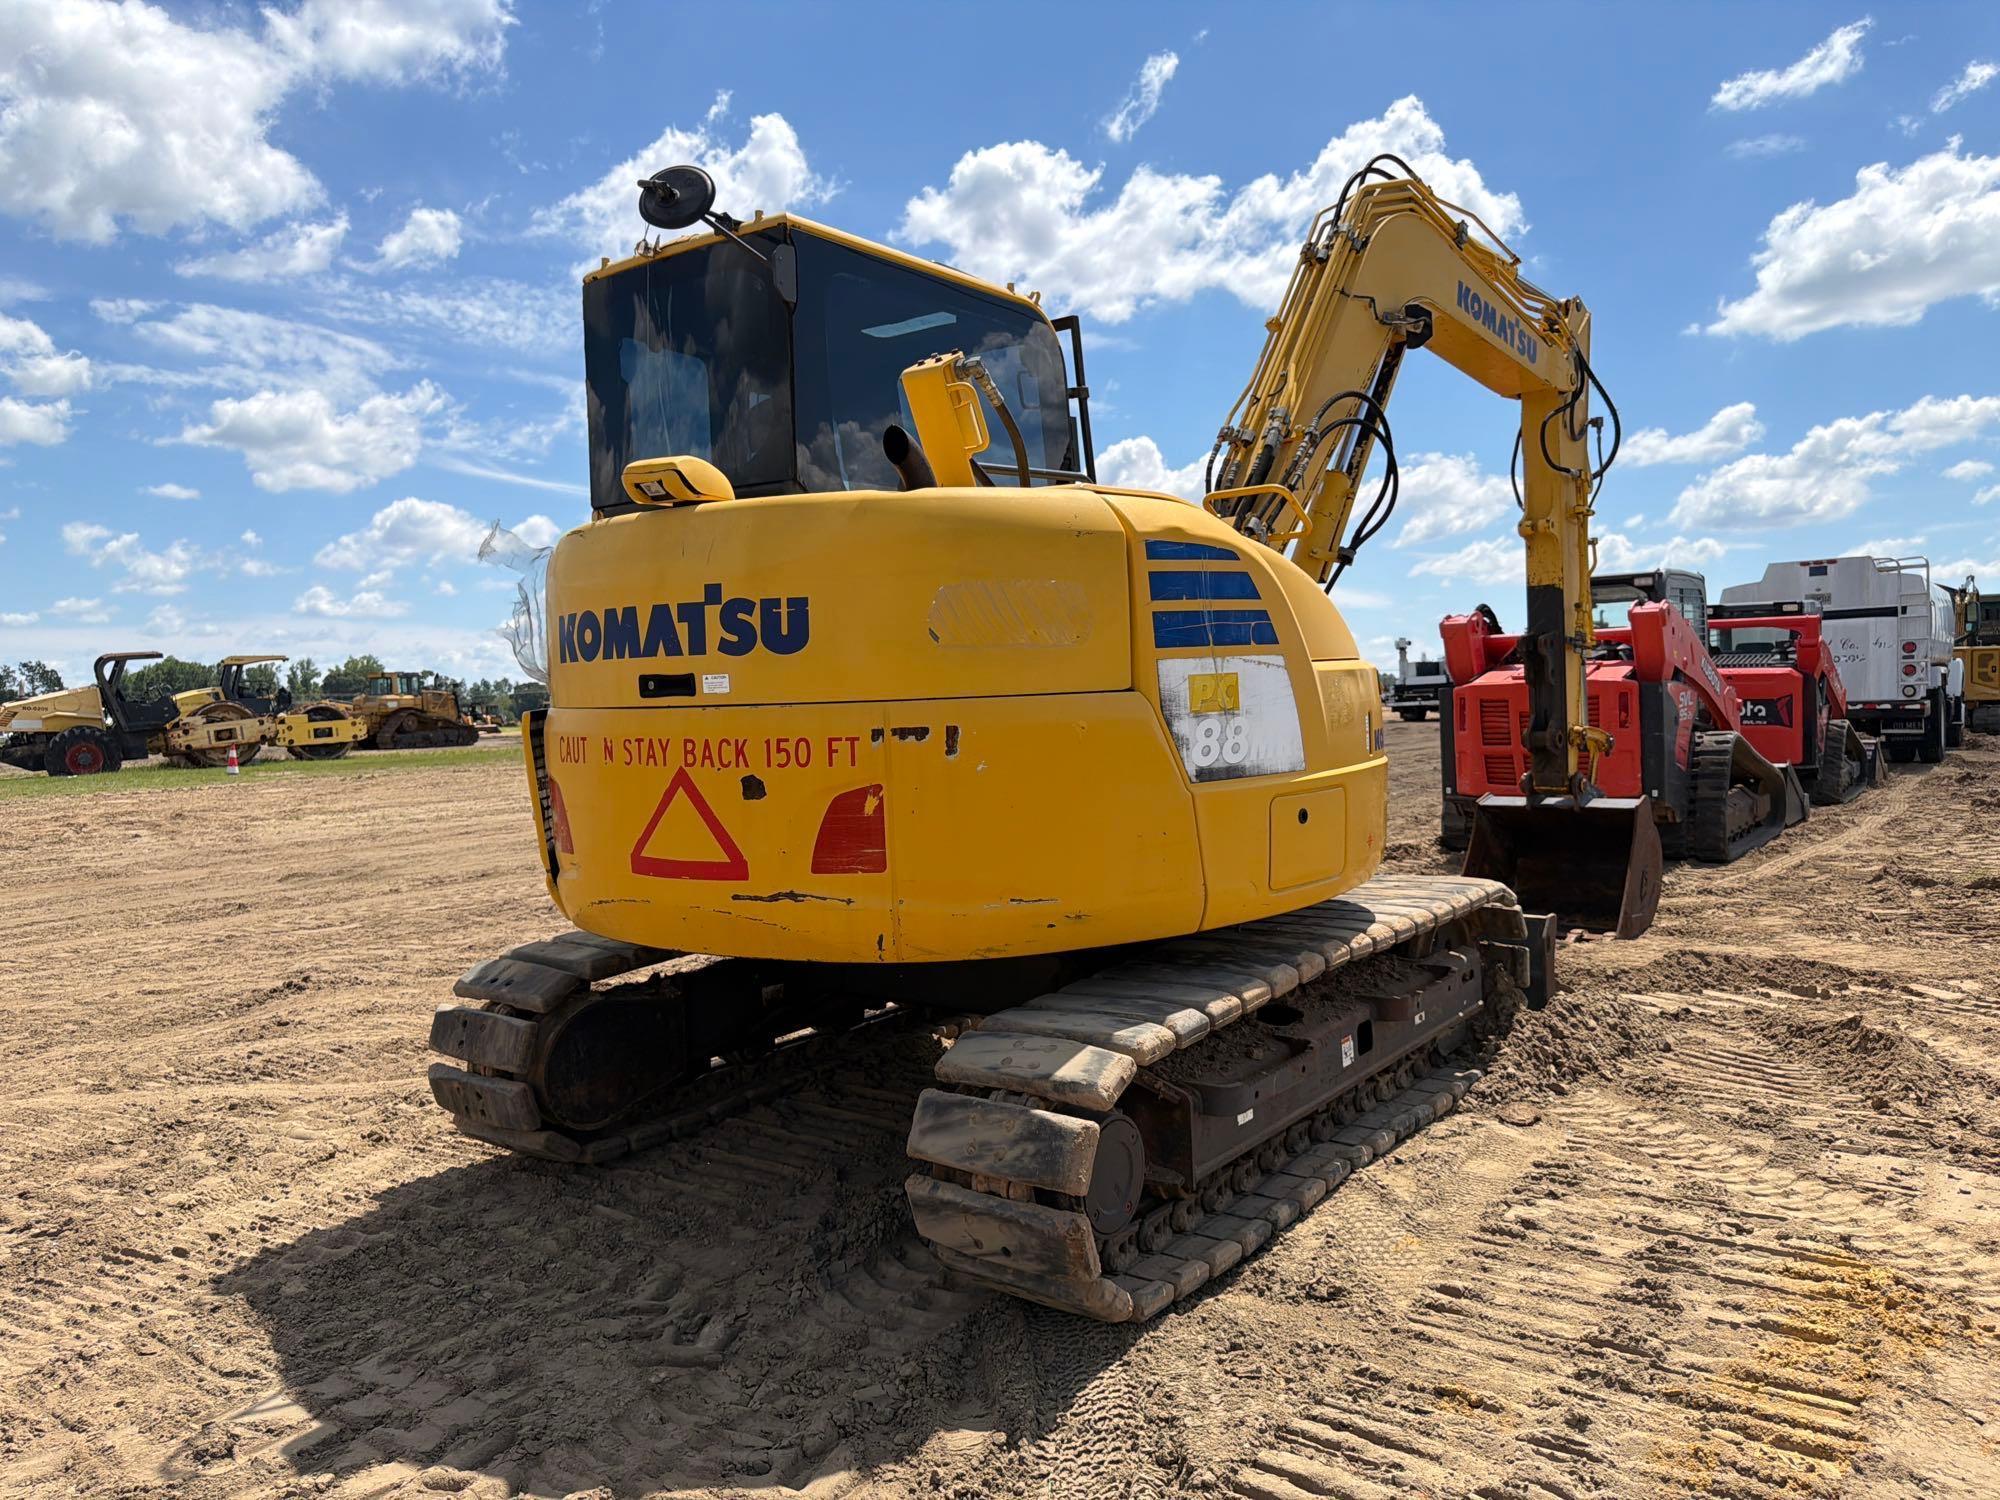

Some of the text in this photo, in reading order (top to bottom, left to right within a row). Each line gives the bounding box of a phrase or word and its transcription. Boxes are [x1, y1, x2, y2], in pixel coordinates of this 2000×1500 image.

[1457, 280, 1537, 364] KOMATSU
[559, 583, 810, 663] KOMATSU
[623, 737, 670, 767] STAY
[683, 738, 750, 768] BACK
[764, 737, 812, 768] 150
[827, 736, 861, 768] FT
[1191, 716, 1250, 768] 88
